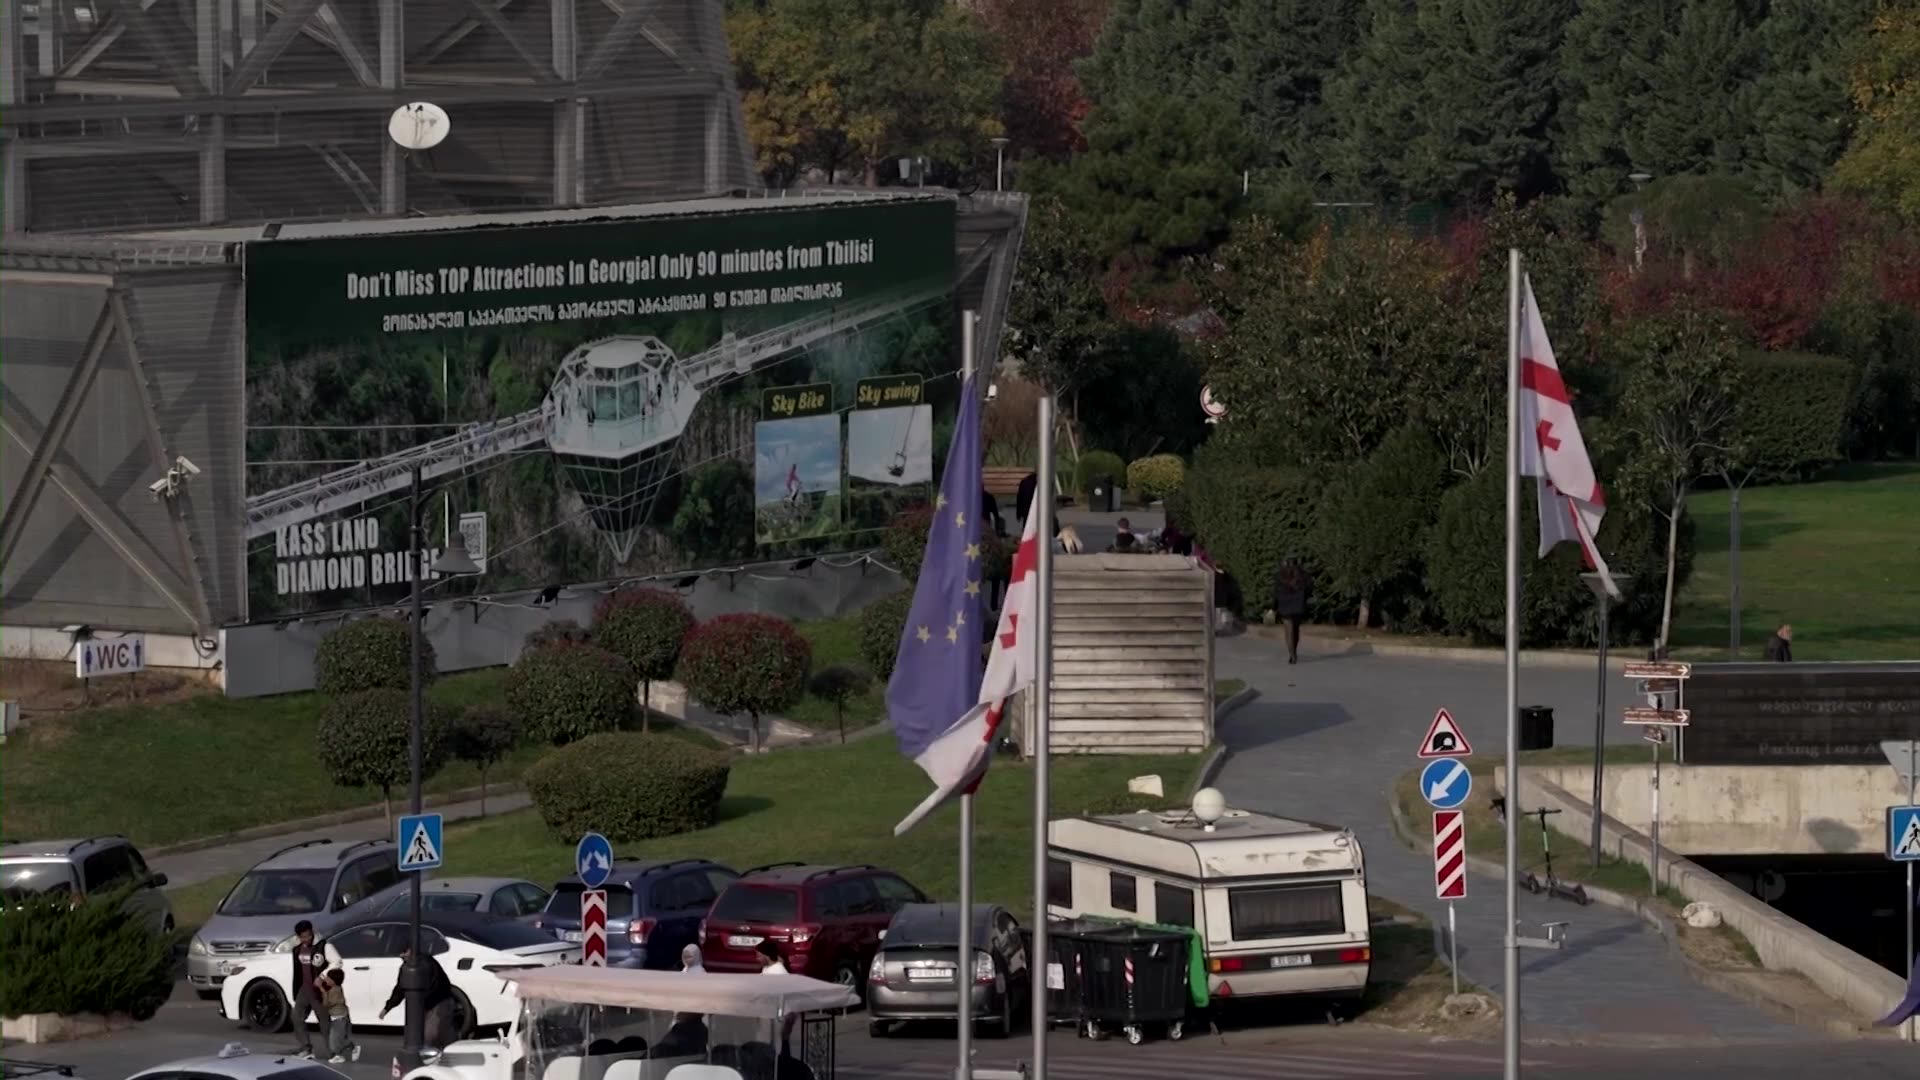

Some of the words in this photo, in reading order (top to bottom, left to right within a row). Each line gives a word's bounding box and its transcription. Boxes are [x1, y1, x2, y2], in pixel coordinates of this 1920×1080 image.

[347, 271, 391, 299] Don't
[395, 270, 434, 296] Miss
[439, 268, 470, 294] TOP
[473, 262, 565, 292] Attractions
[659, 253, 694, 279] Only
[697, 251, 717, 276] 90
[721, 249, 783, 274] minutes
[786, 245, 822, 270] from
[826, 238, 874, 265] Tbilisi
[713, 291, 727, 309] 90
[771, 394, 796, 416] Sky
[798, 390, 825, 410] Bike
[858, 385, 883, 405] Sky
[884, 380, 921, 403] swing
[275, 521, 326, 558] KASS
[331, 517, 380, 553] LAND
[276, 555, 366, 595] DIAMOND
[97, 643, 130, 670] WC
